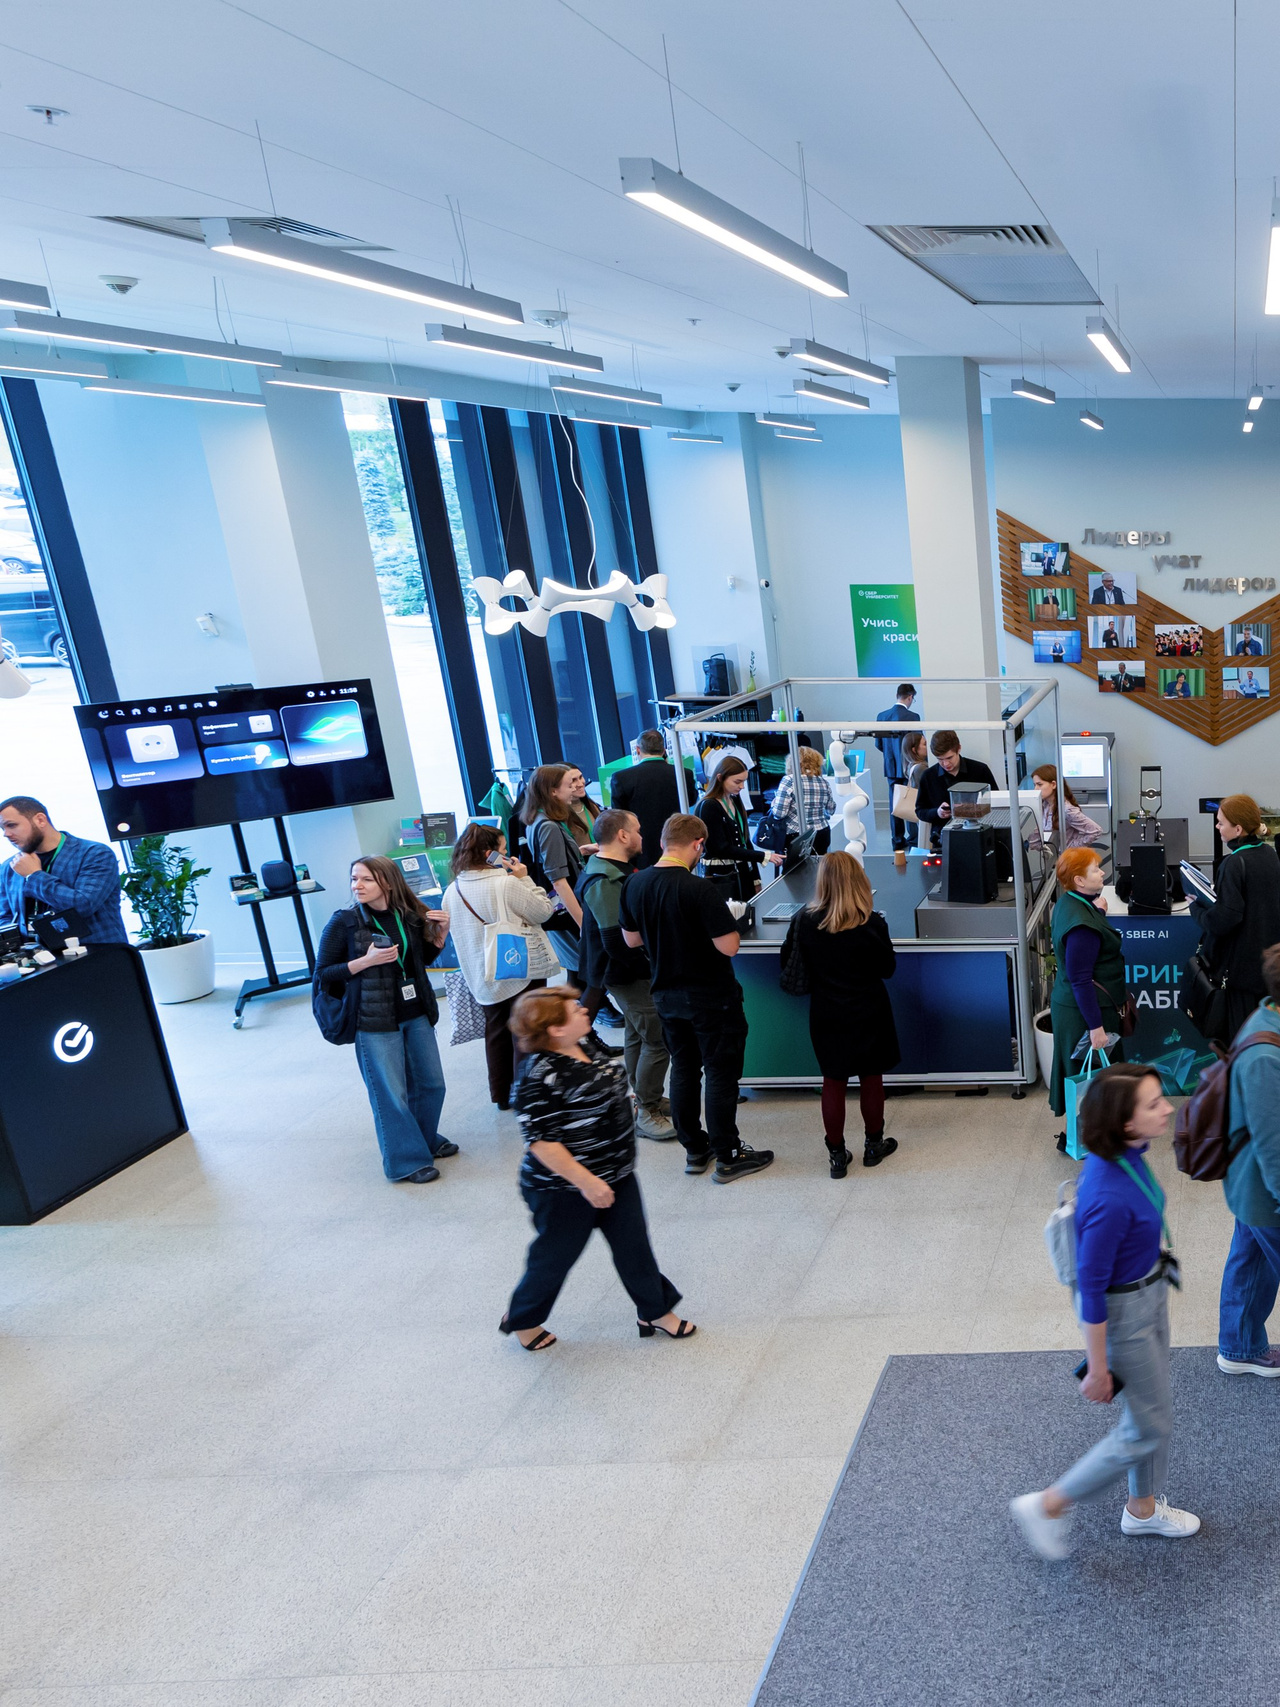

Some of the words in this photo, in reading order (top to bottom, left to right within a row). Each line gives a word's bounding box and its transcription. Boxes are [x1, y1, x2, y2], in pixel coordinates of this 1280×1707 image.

[1081, 528, 1172, 549] Лидеры
[1152, 554, 1203, 573] учат
[1182, 577, 1277, 596] лидеров
[861, 617, 899, 628] Учись
[1126, 930, 1155, 939] SBER
[1158, 930, 1169, 939] AI
